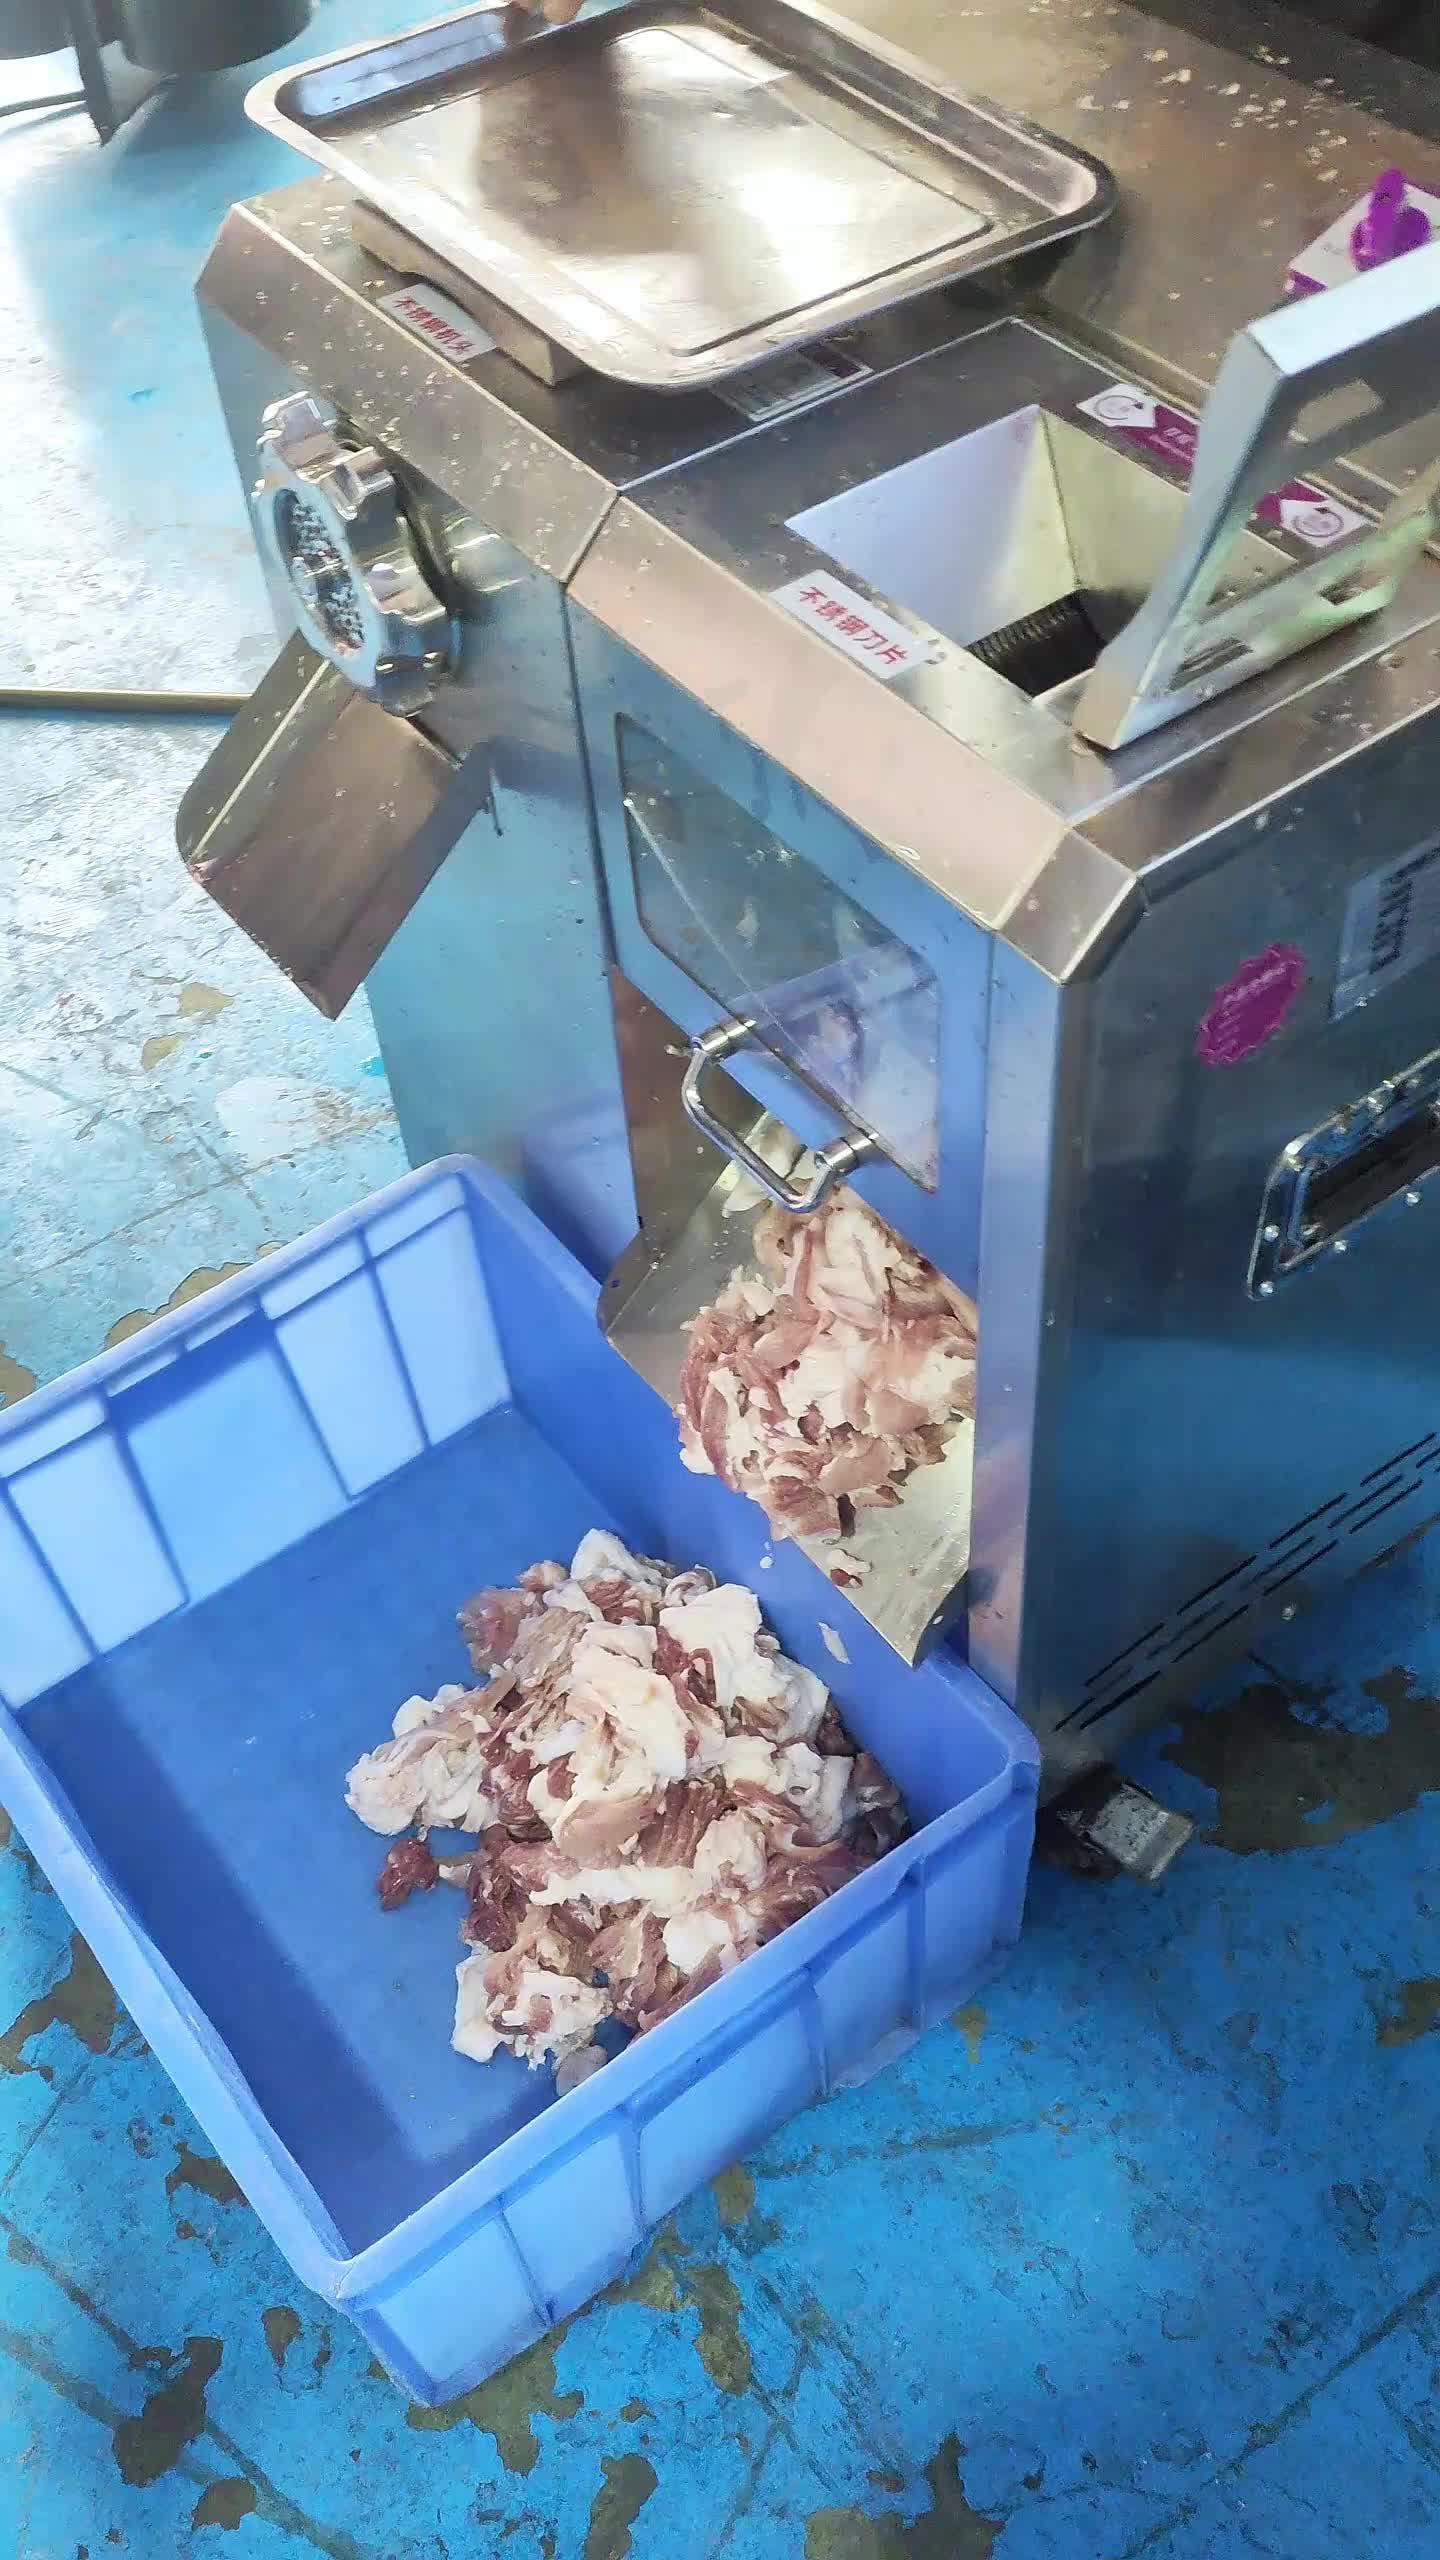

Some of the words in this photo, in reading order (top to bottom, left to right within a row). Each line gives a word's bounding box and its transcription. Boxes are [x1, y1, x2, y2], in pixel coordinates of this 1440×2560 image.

[799, 586, 908, 665] 不锈钢刀片
